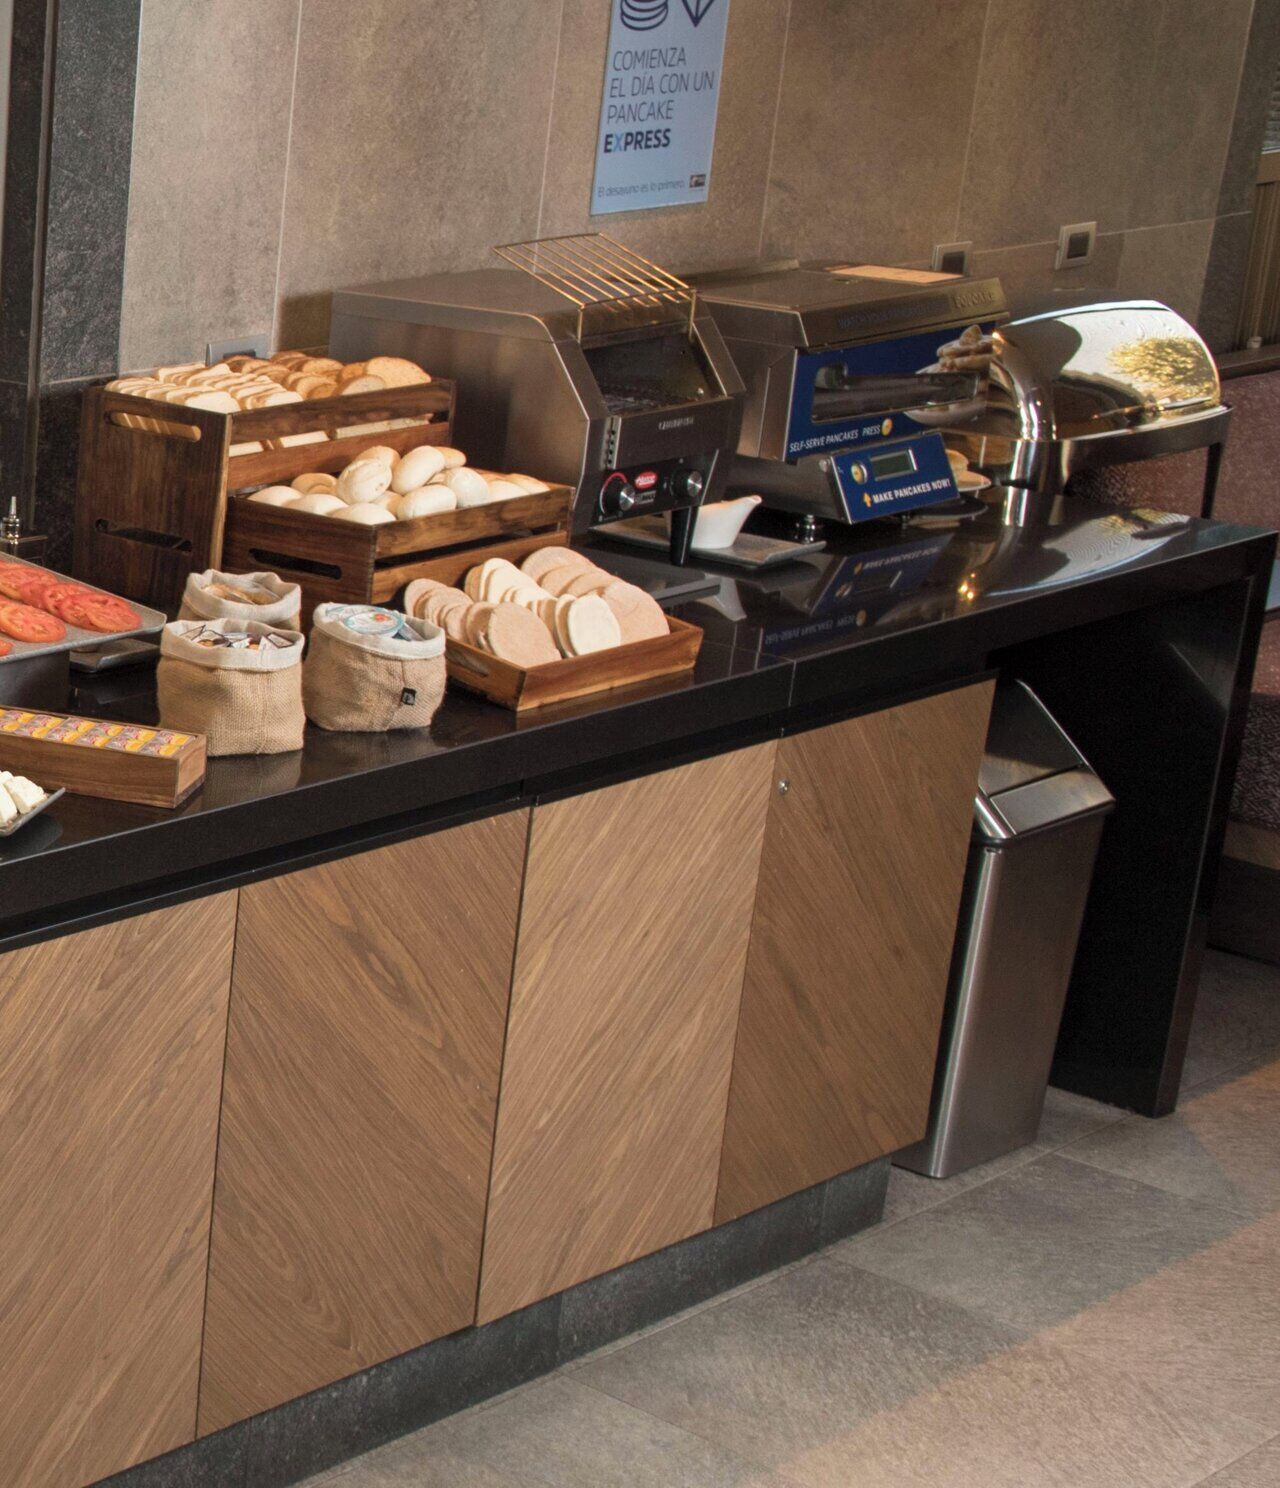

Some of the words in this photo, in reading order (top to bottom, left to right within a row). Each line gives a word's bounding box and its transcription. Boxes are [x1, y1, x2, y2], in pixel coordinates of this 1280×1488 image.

[612, 47, 686, 71] COMIENZA
[609, 78, 626, 98] EL
[631, 72, 654, 96] DÍA
[659, 73, 690, 95] CON
[693, 71, 715, 92] UN
[607, 100, 674, 124] PANCAKE
[603, 128, 671, 153] EXPRESS
[789, 436, 826, 453] SELF-SERVE
[826, 429, 859, 444] PANCAKES
[862, 424, 881, 437] PRESS
[872, 491, 894, 504] MAKE
[894, 482, 931, 499] PANCAKES
[931, 478, 952, 490] NOW!
